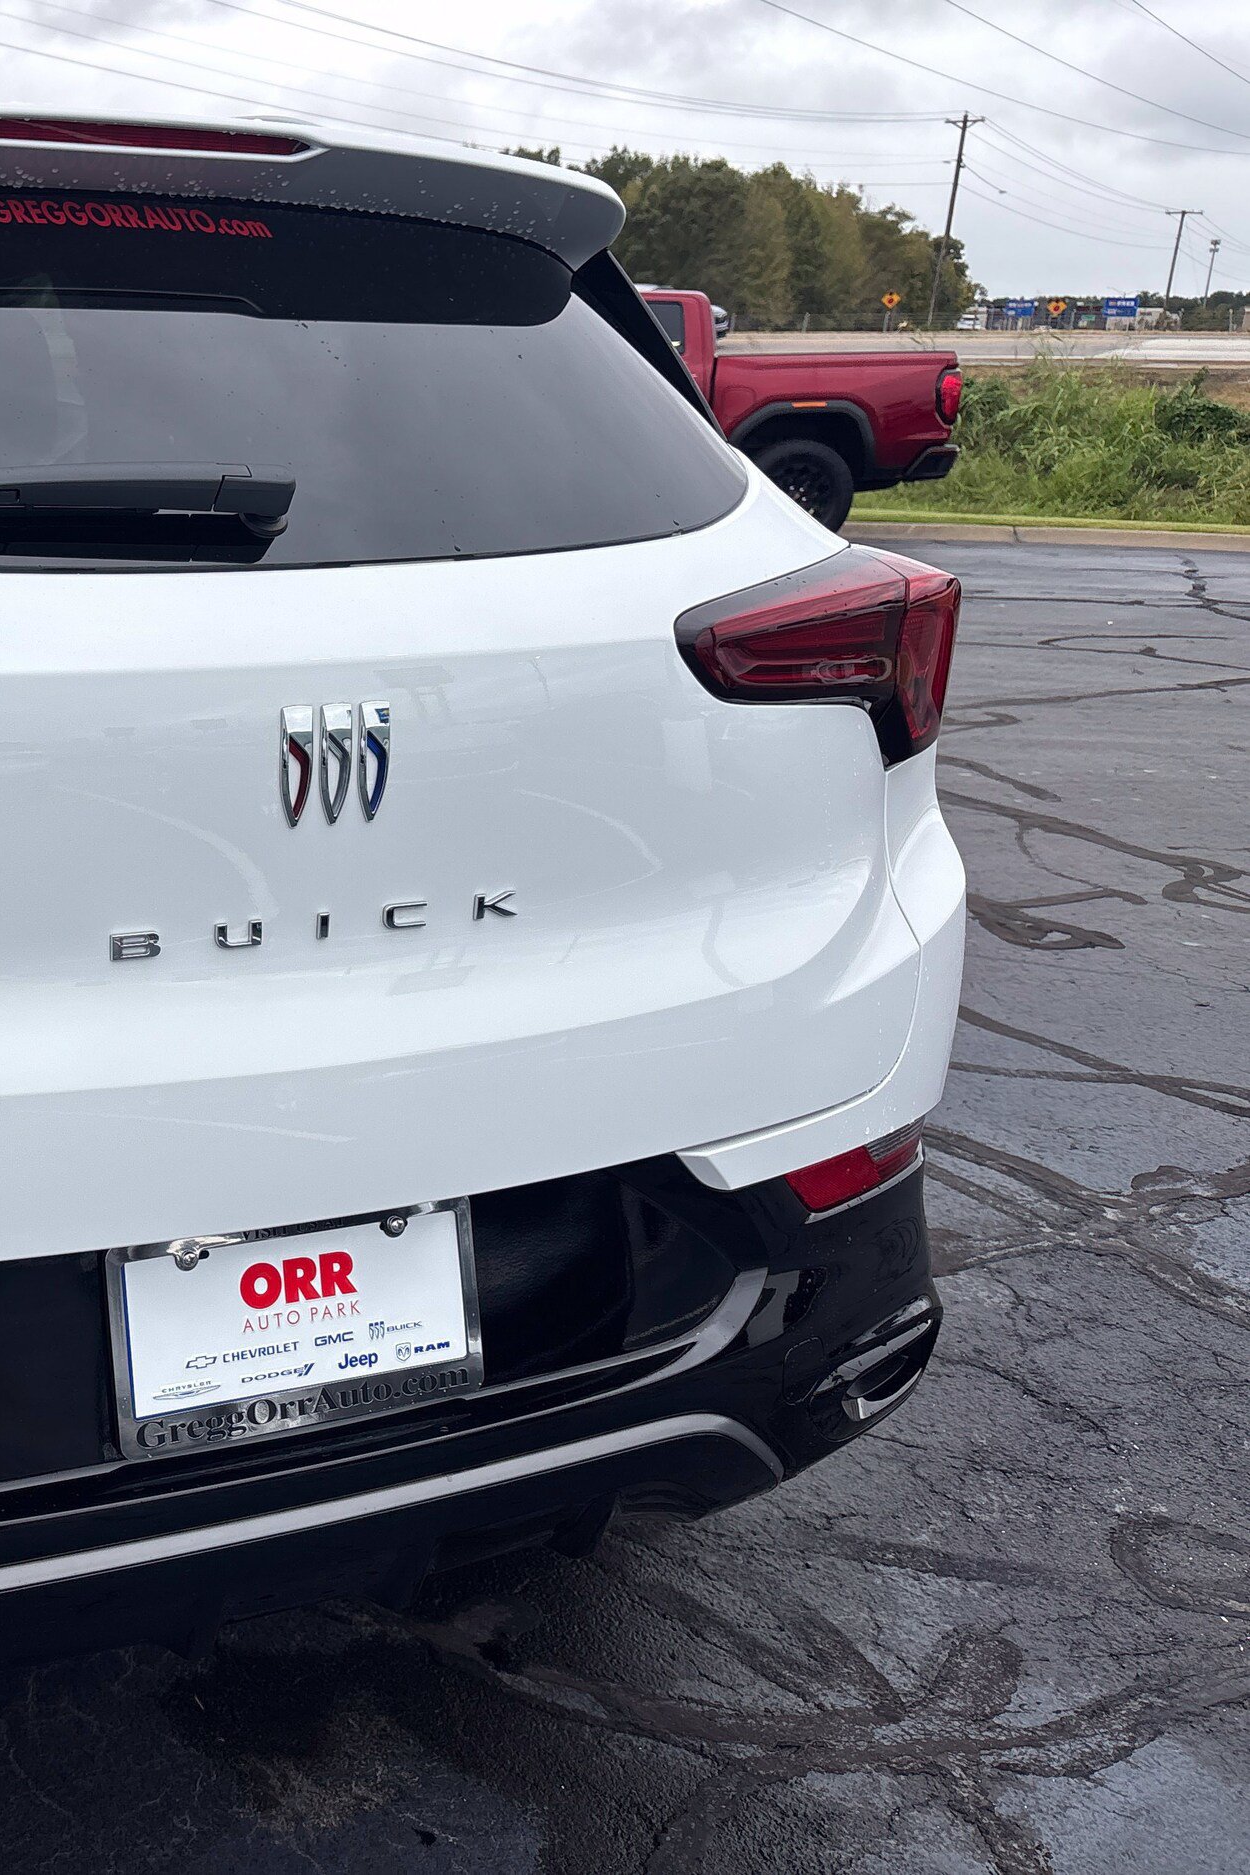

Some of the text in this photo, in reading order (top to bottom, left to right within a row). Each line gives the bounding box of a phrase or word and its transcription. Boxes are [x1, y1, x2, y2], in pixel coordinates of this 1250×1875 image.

[109, 889, 518, 962] BUICK
[239, 1250, 358, 1310] ORR
[243, 1299, 362, 1334] AUTO PARK
[386, 1320, 423, 1333] BUICK
[314, 1331, 355, 1348] GMC
[414, 1341, 451, 1354] RAM
[222, 1340, 300, 1364] CHEVROLET
[338, 1351, 379, 1371] Jeep
[241, 1366, 304, 1384] DODGE
[161, 1380, 212, 1394] CHRYSLER
[136, 1366, 470, 1450] GreggOrrAuto.com
